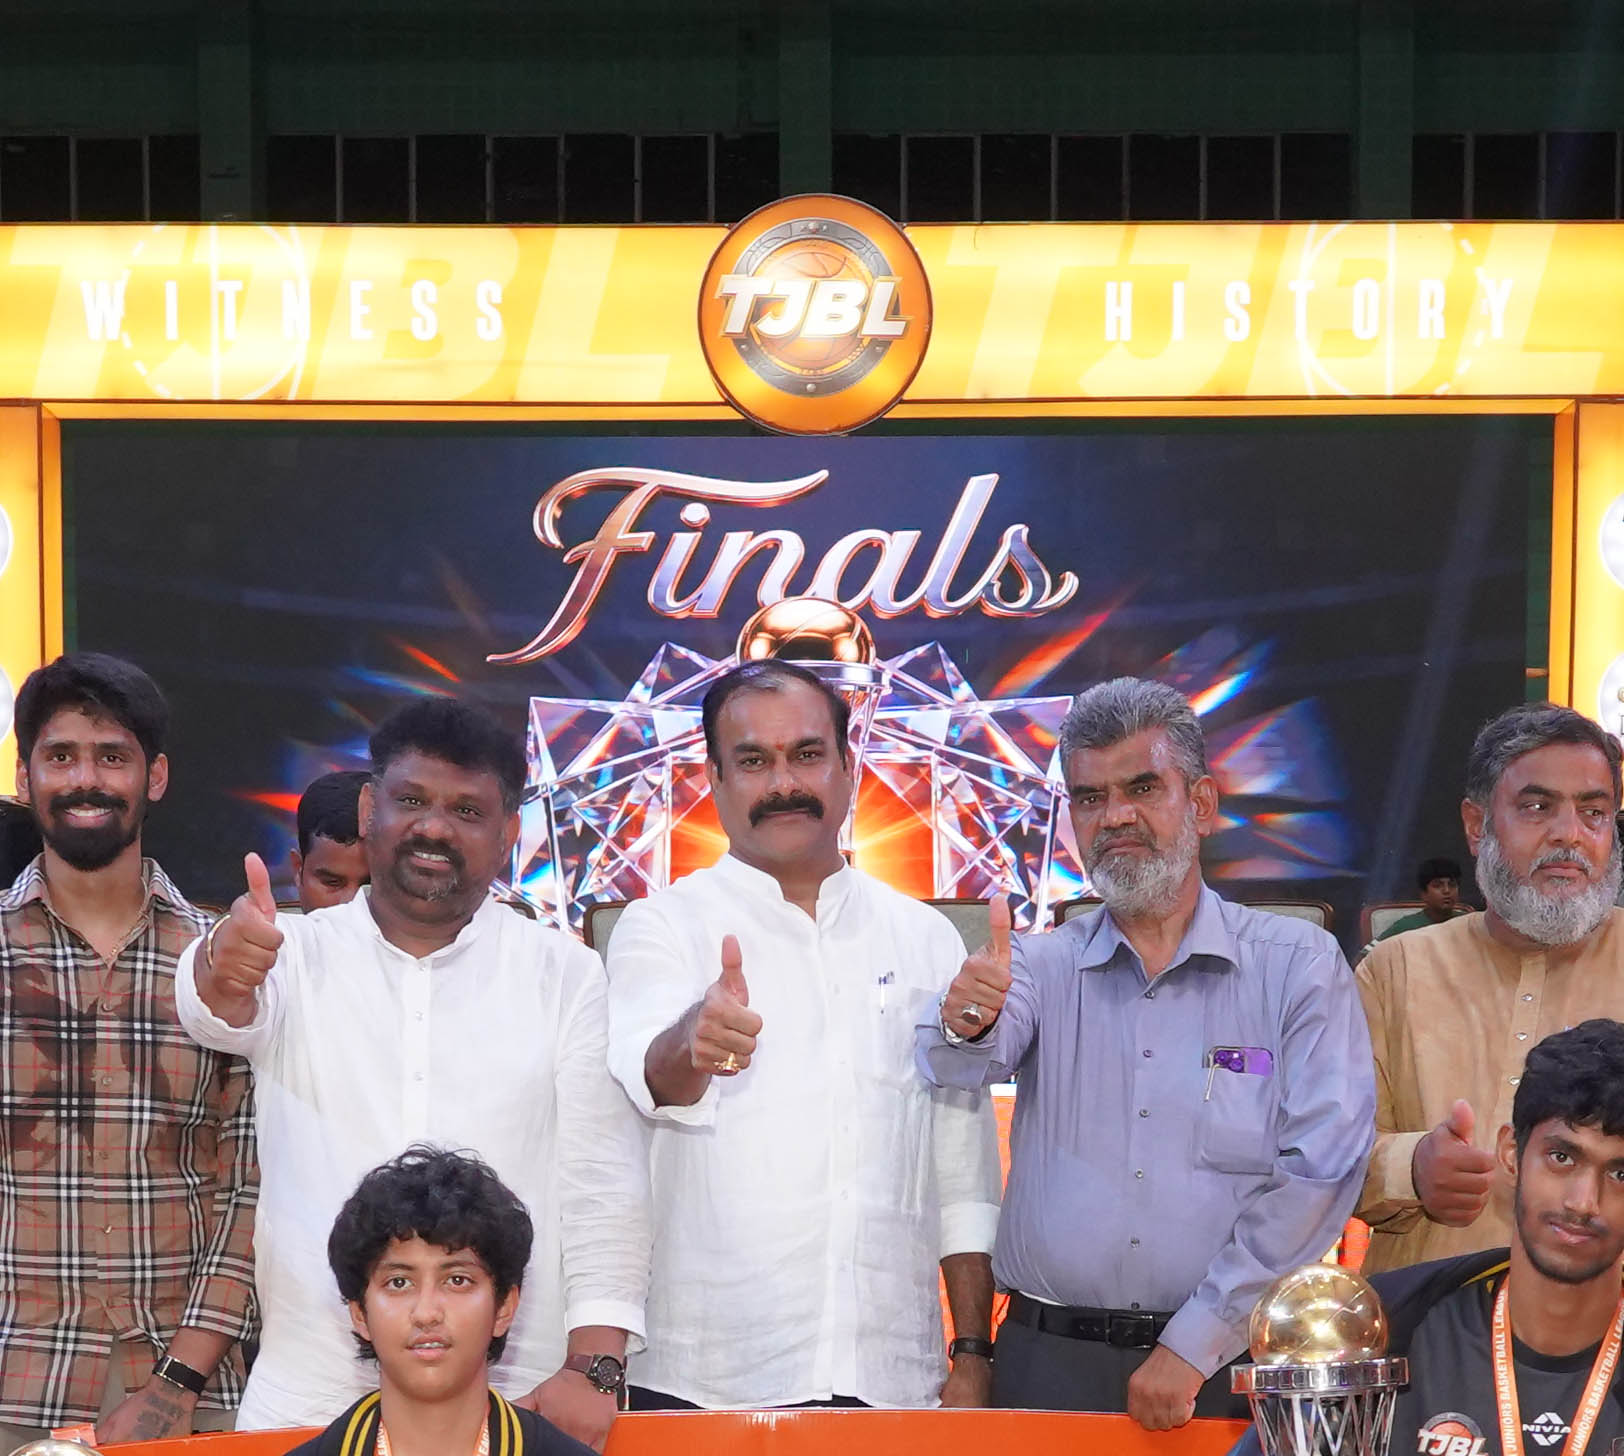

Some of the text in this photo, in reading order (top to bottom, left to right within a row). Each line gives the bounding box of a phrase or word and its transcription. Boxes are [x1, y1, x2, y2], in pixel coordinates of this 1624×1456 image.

[82, 280, 505, 342] WITNESS
[716, 275, 912, 338] TJBL
[1104, 279, 1512, 341] HISTORY
[487, 467, 1078, 663] Finals
[1495, 1331, 1512, 1401] BASKETBALL
[1589, 1341, 1620, 1408] BASKETBALL
[1500, 1403, 1518, 1454] JUNIORS
